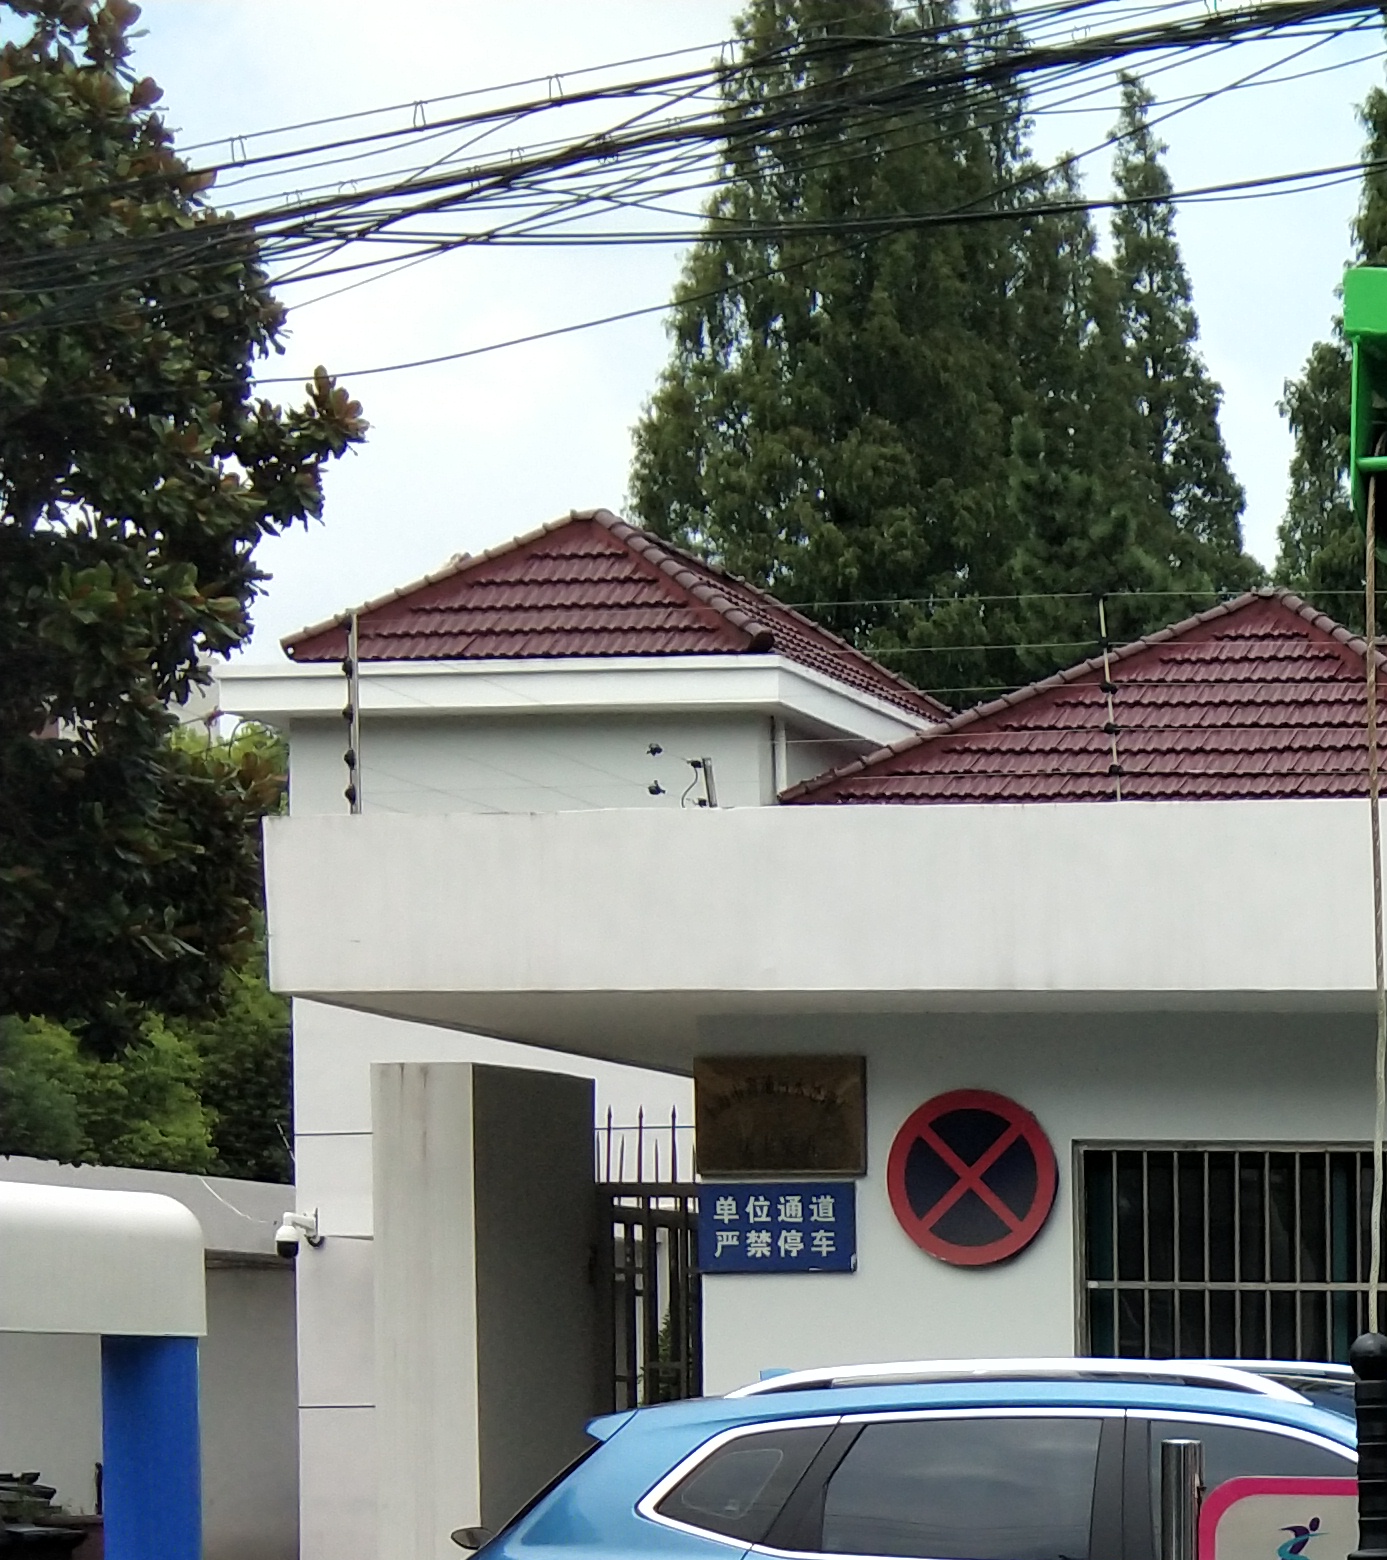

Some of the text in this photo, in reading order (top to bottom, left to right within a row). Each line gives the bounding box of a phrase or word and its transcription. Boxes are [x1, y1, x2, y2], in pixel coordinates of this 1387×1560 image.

[713, 1195, 836, 1223] 单位通道
[715, 1230, 837, 1258] 严禁停车
